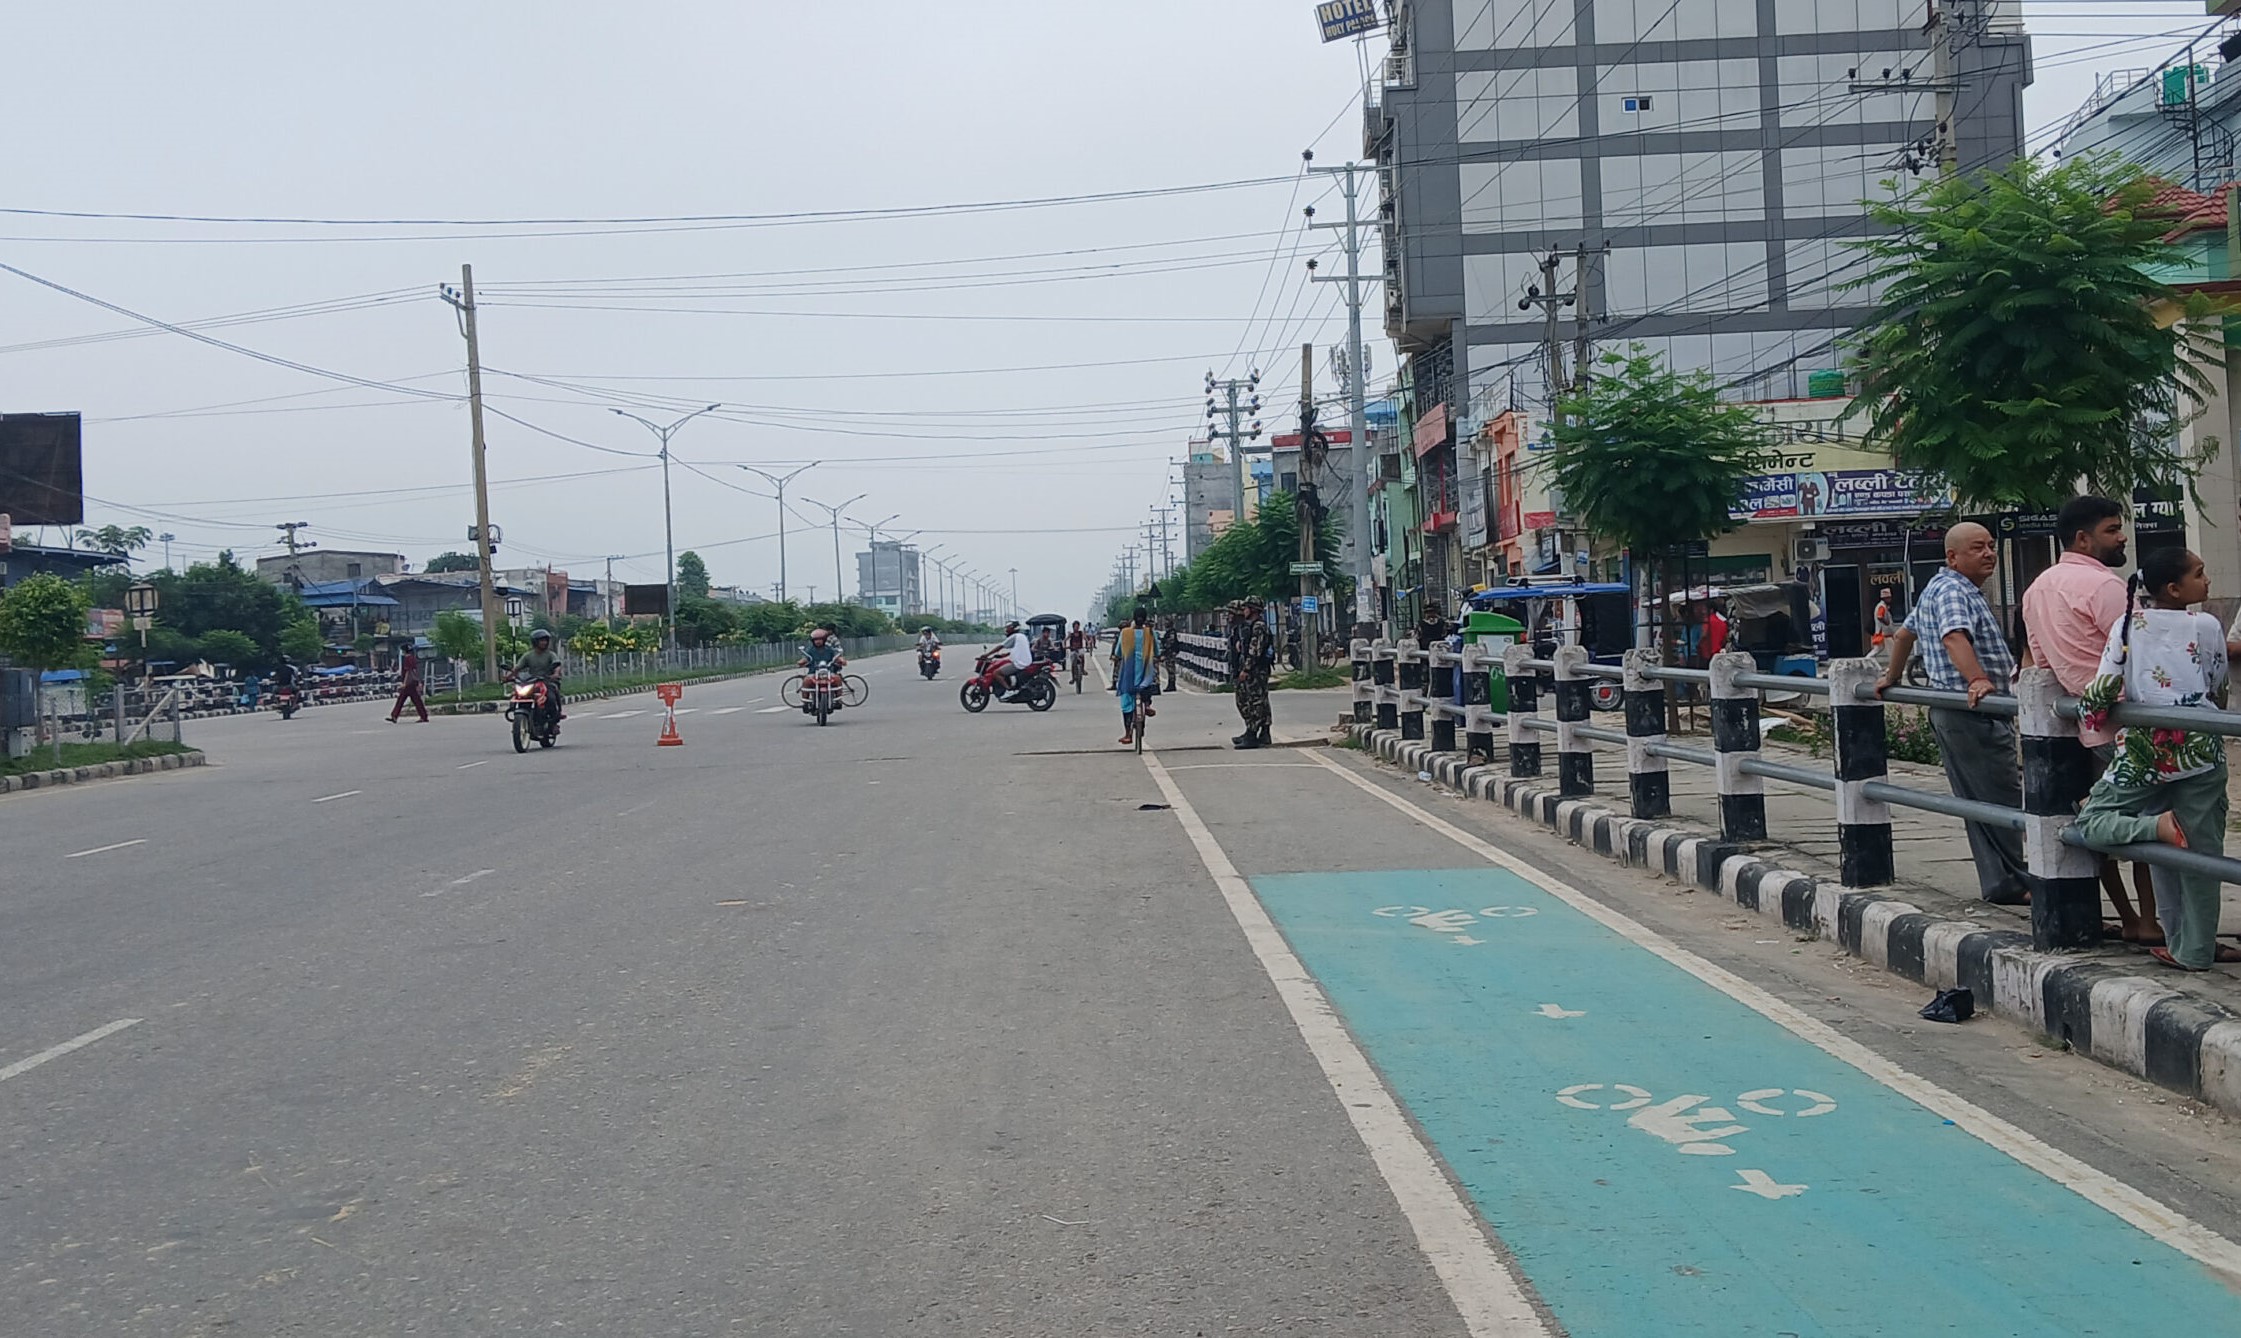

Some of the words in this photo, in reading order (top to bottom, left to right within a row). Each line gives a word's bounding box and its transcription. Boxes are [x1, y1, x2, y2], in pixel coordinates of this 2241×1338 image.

[1320, 0, 1371, 23] HOTEL
[1325, 22, 1345, 38] HOLY
[1834, 472, 1888, 492] लब्ली
